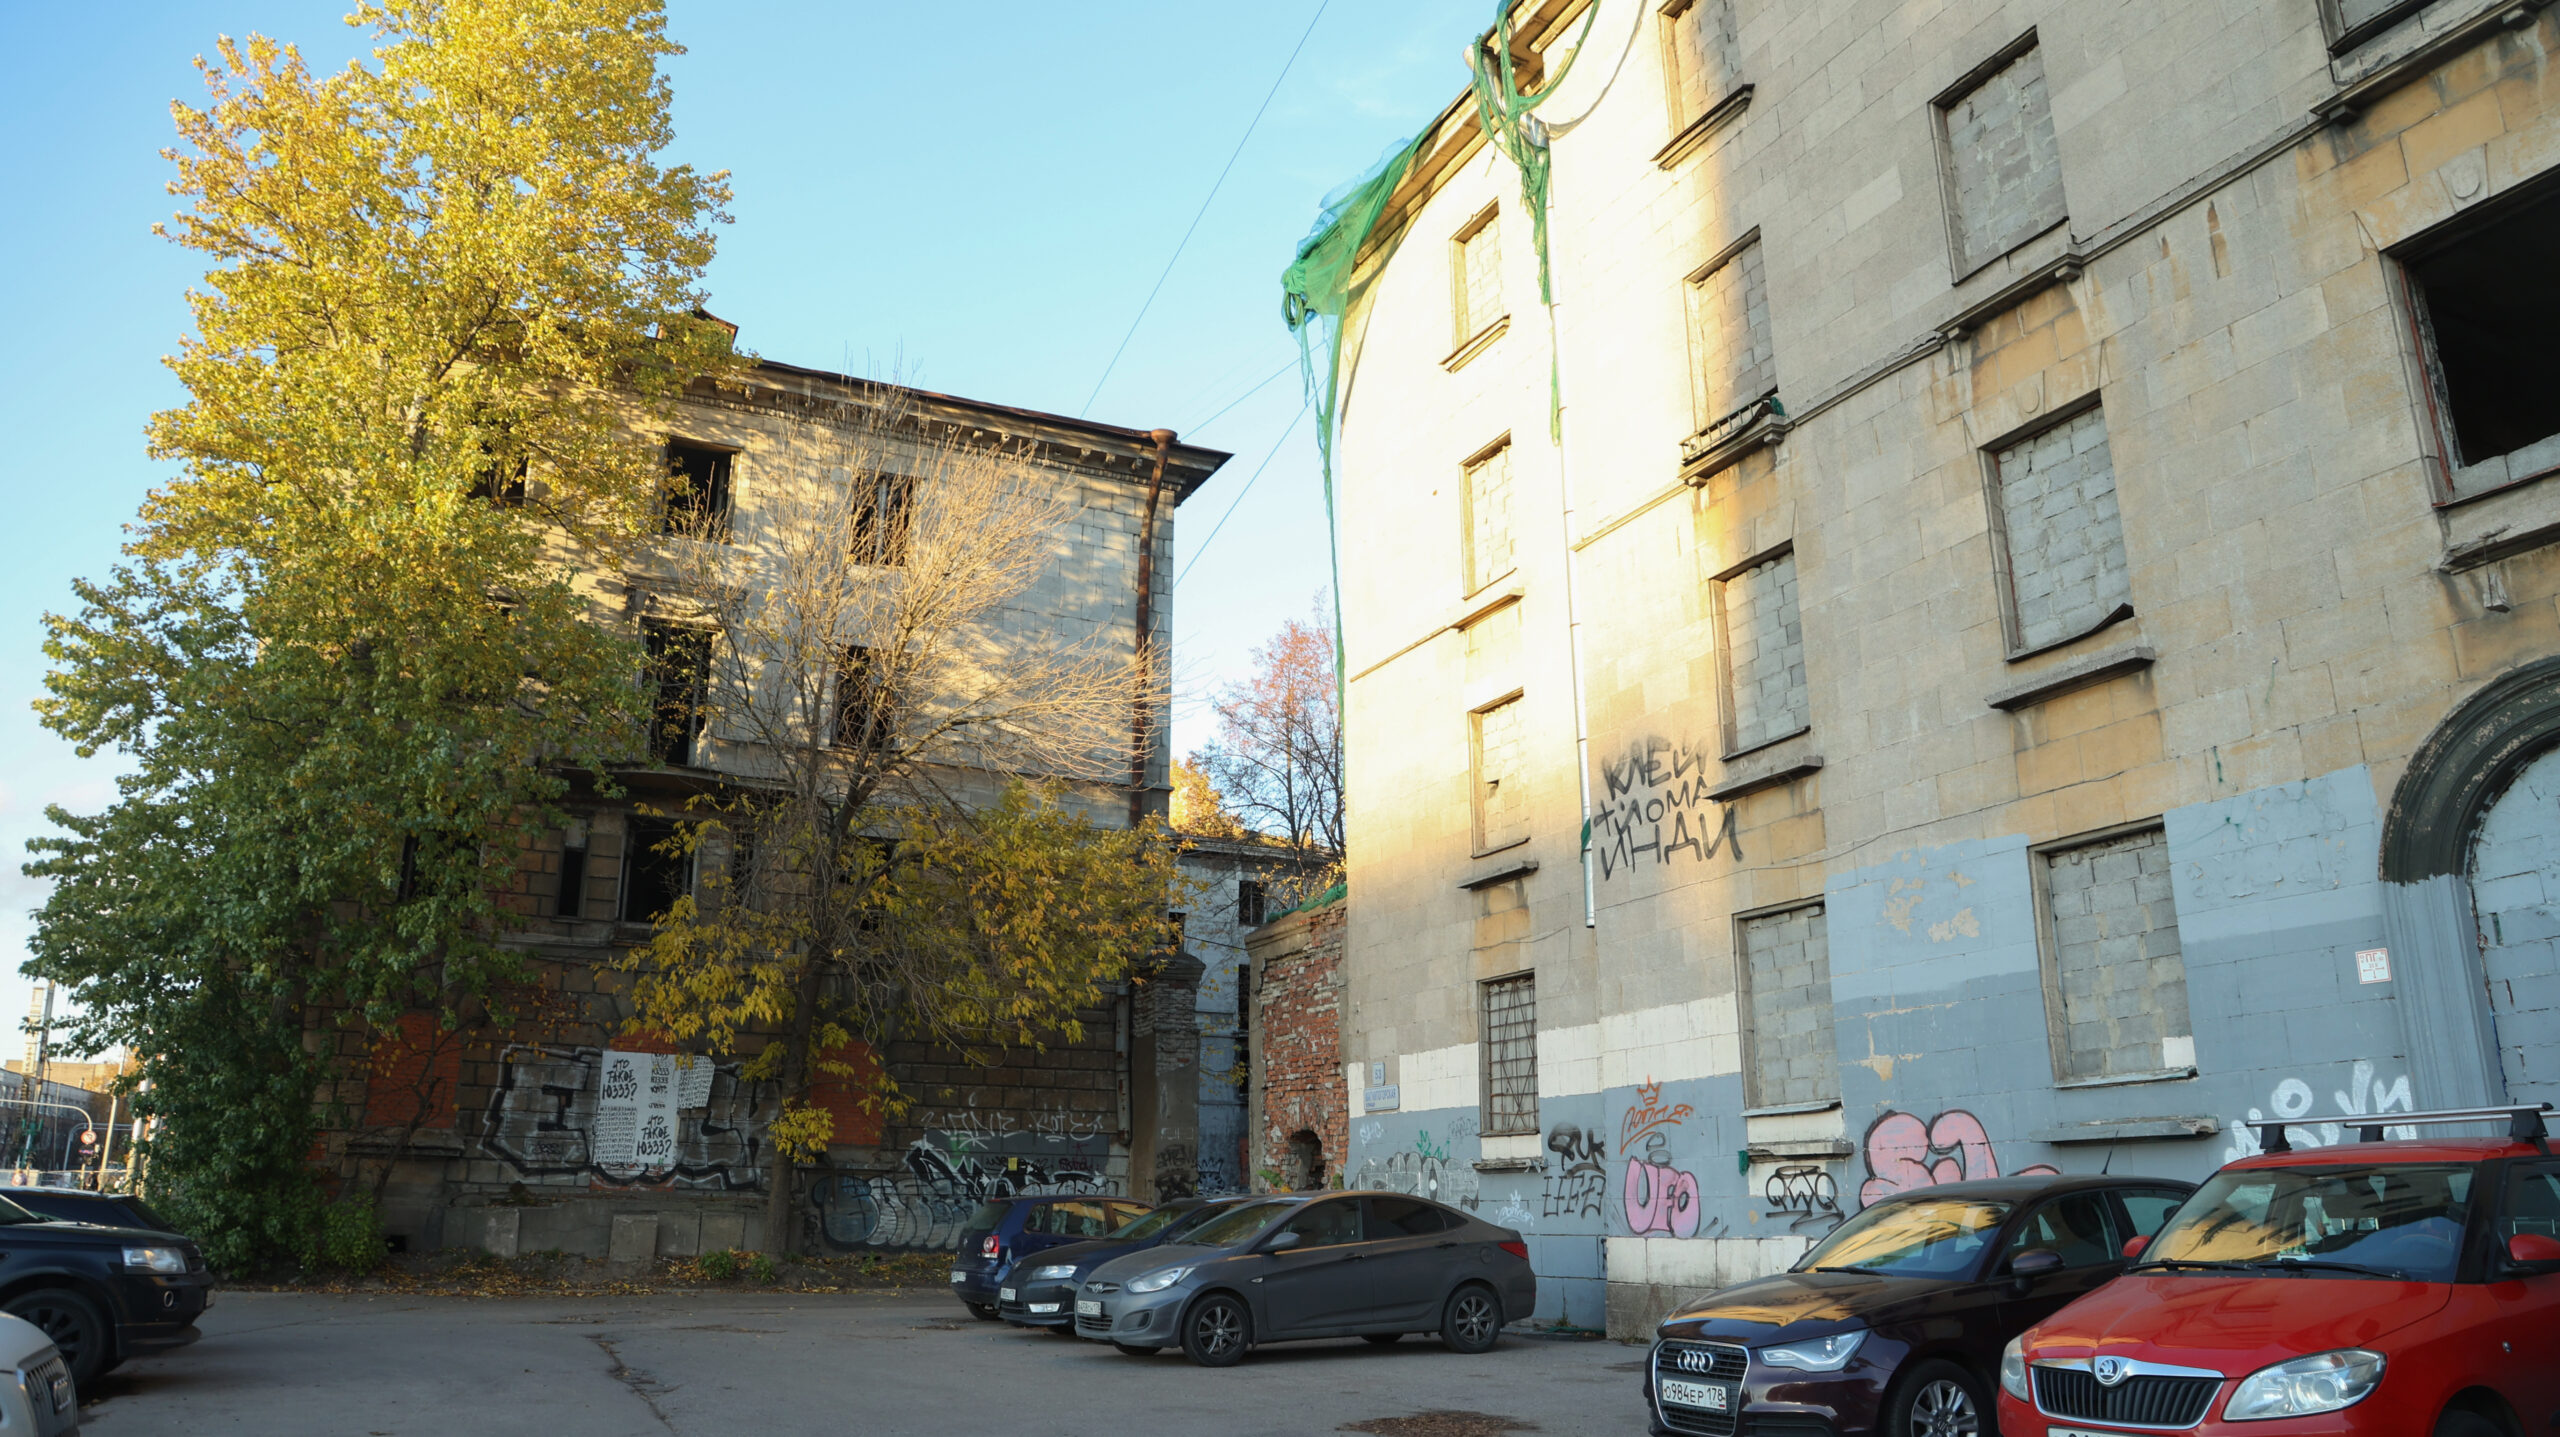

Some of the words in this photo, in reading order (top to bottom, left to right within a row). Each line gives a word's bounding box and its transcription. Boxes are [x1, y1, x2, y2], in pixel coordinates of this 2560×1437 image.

[1601, 803, 1744, 881] ИНДИ
[613, 1059, 630, 1071] ЧТО
[606, 1070, 635, 1083] ТАКОЕ
[647, 1115, 665, 1128] ЧТО
[641, 1126, 670, 1140] ТАКОЕ
[1624, 1157, 1700, 1238] UFO
[1707, 1387, 1724, 1402] 178
